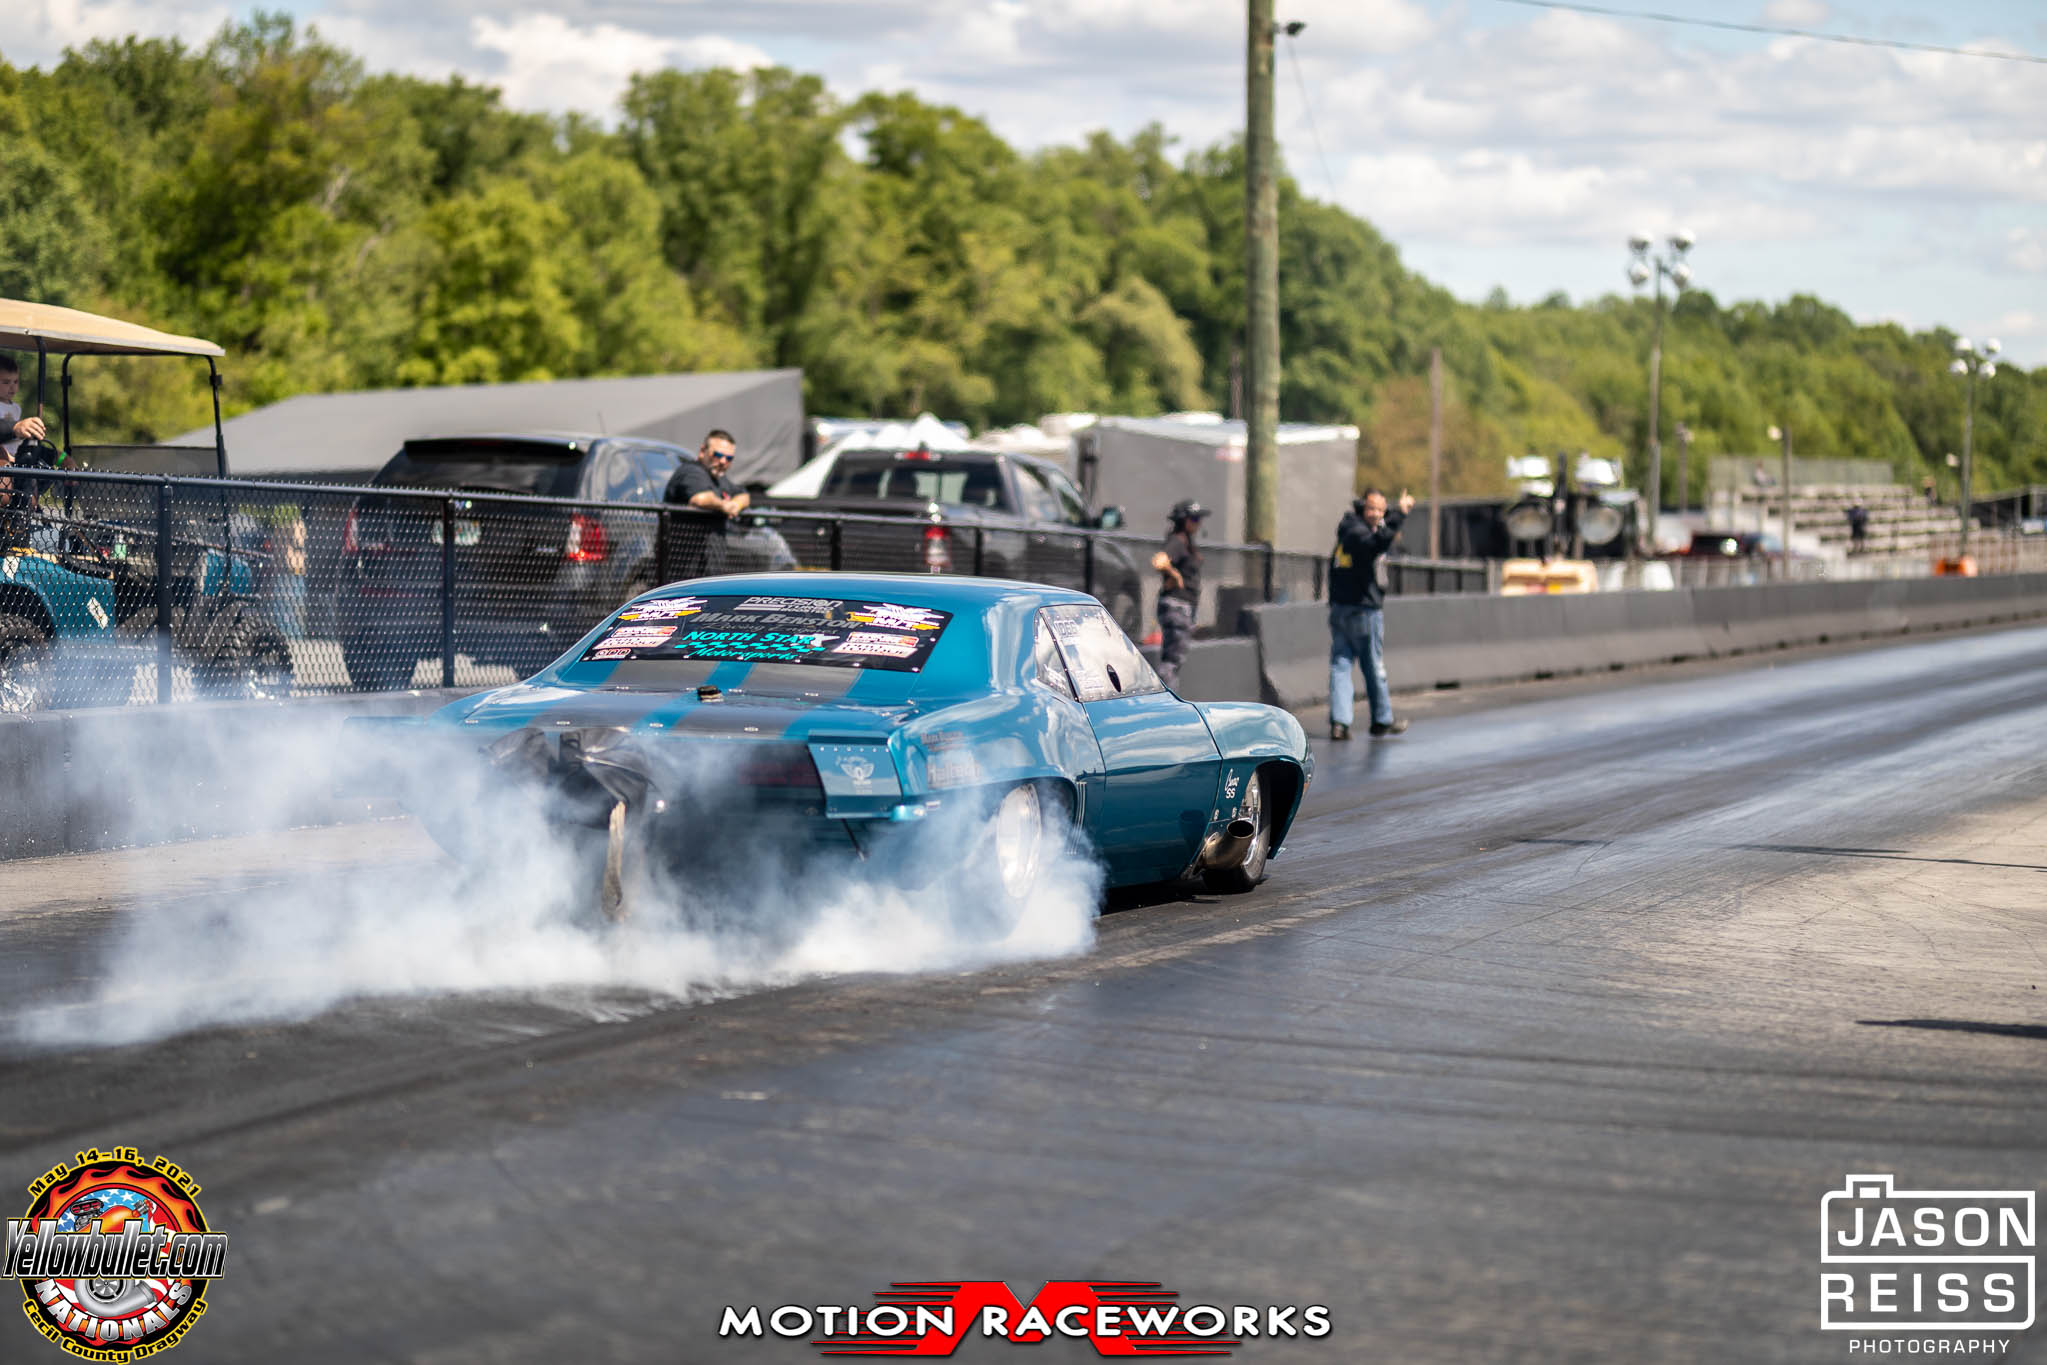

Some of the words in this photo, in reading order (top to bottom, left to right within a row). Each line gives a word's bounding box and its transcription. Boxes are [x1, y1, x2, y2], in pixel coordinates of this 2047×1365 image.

[744, 597, 843, 607] PRECISION
[690, 612, 761, 623] MARK
[760, 613, 860, 629] BENSTON
[682, 631, 757, 642] NORTH
[759, 632, 816, 645] STAR
[687, 647, 798, 661] Motorsports
